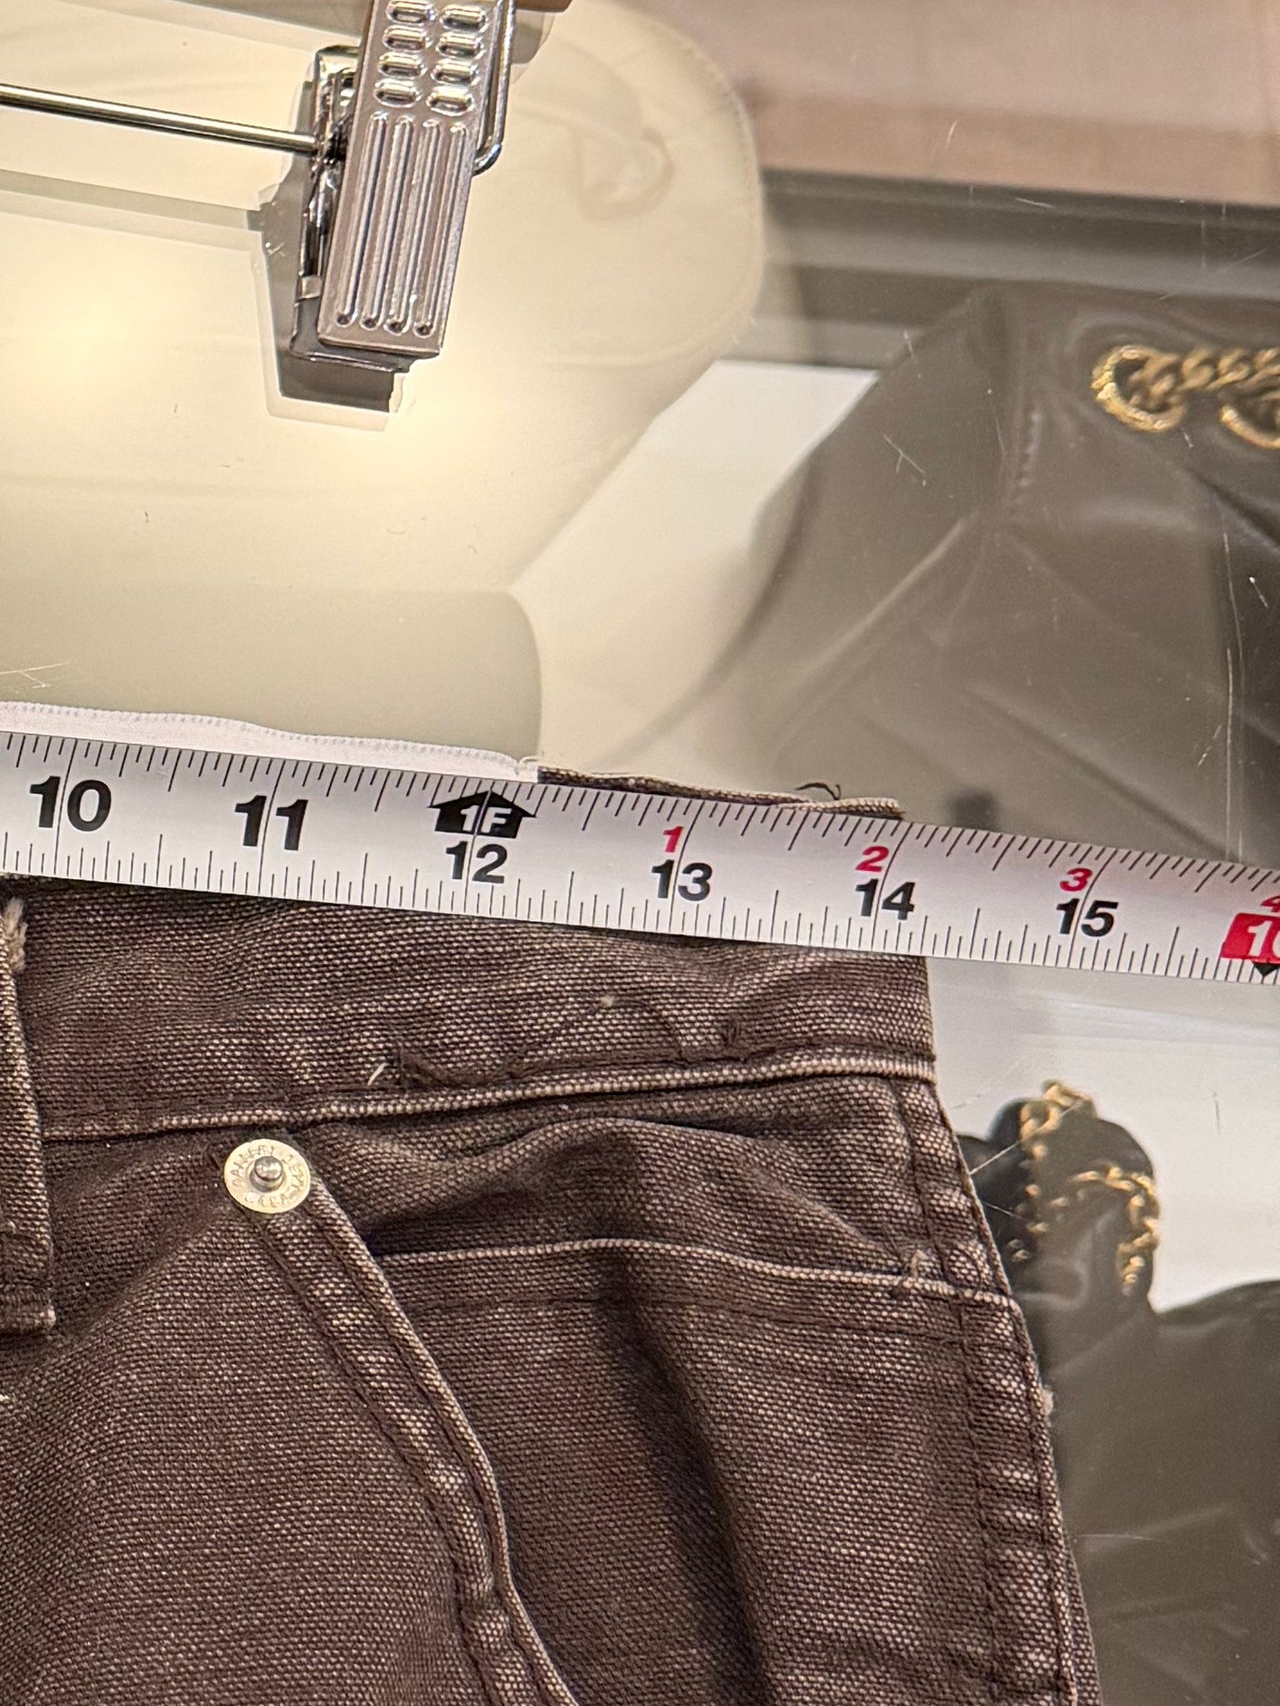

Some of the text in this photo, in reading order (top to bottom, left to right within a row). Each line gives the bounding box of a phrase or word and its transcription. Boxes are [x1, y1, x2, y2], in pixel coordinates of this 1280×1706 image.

[29, 775, 113, 832] 10
[235, 795, 309, 851] 11
[460, 804, 512, 833] 1F
[662, 825, 684, 853] 1
[855, 845, 890, 873] 2
[445, 840, 508, 884] 12
[651, 859, 713, 902] 13
[1059, 867, 1093, 892] 3
[855, 879, 916, 920] 14
[1055, 898, 1119, 938] 15
[1247, 919, 1280, 959] 1
